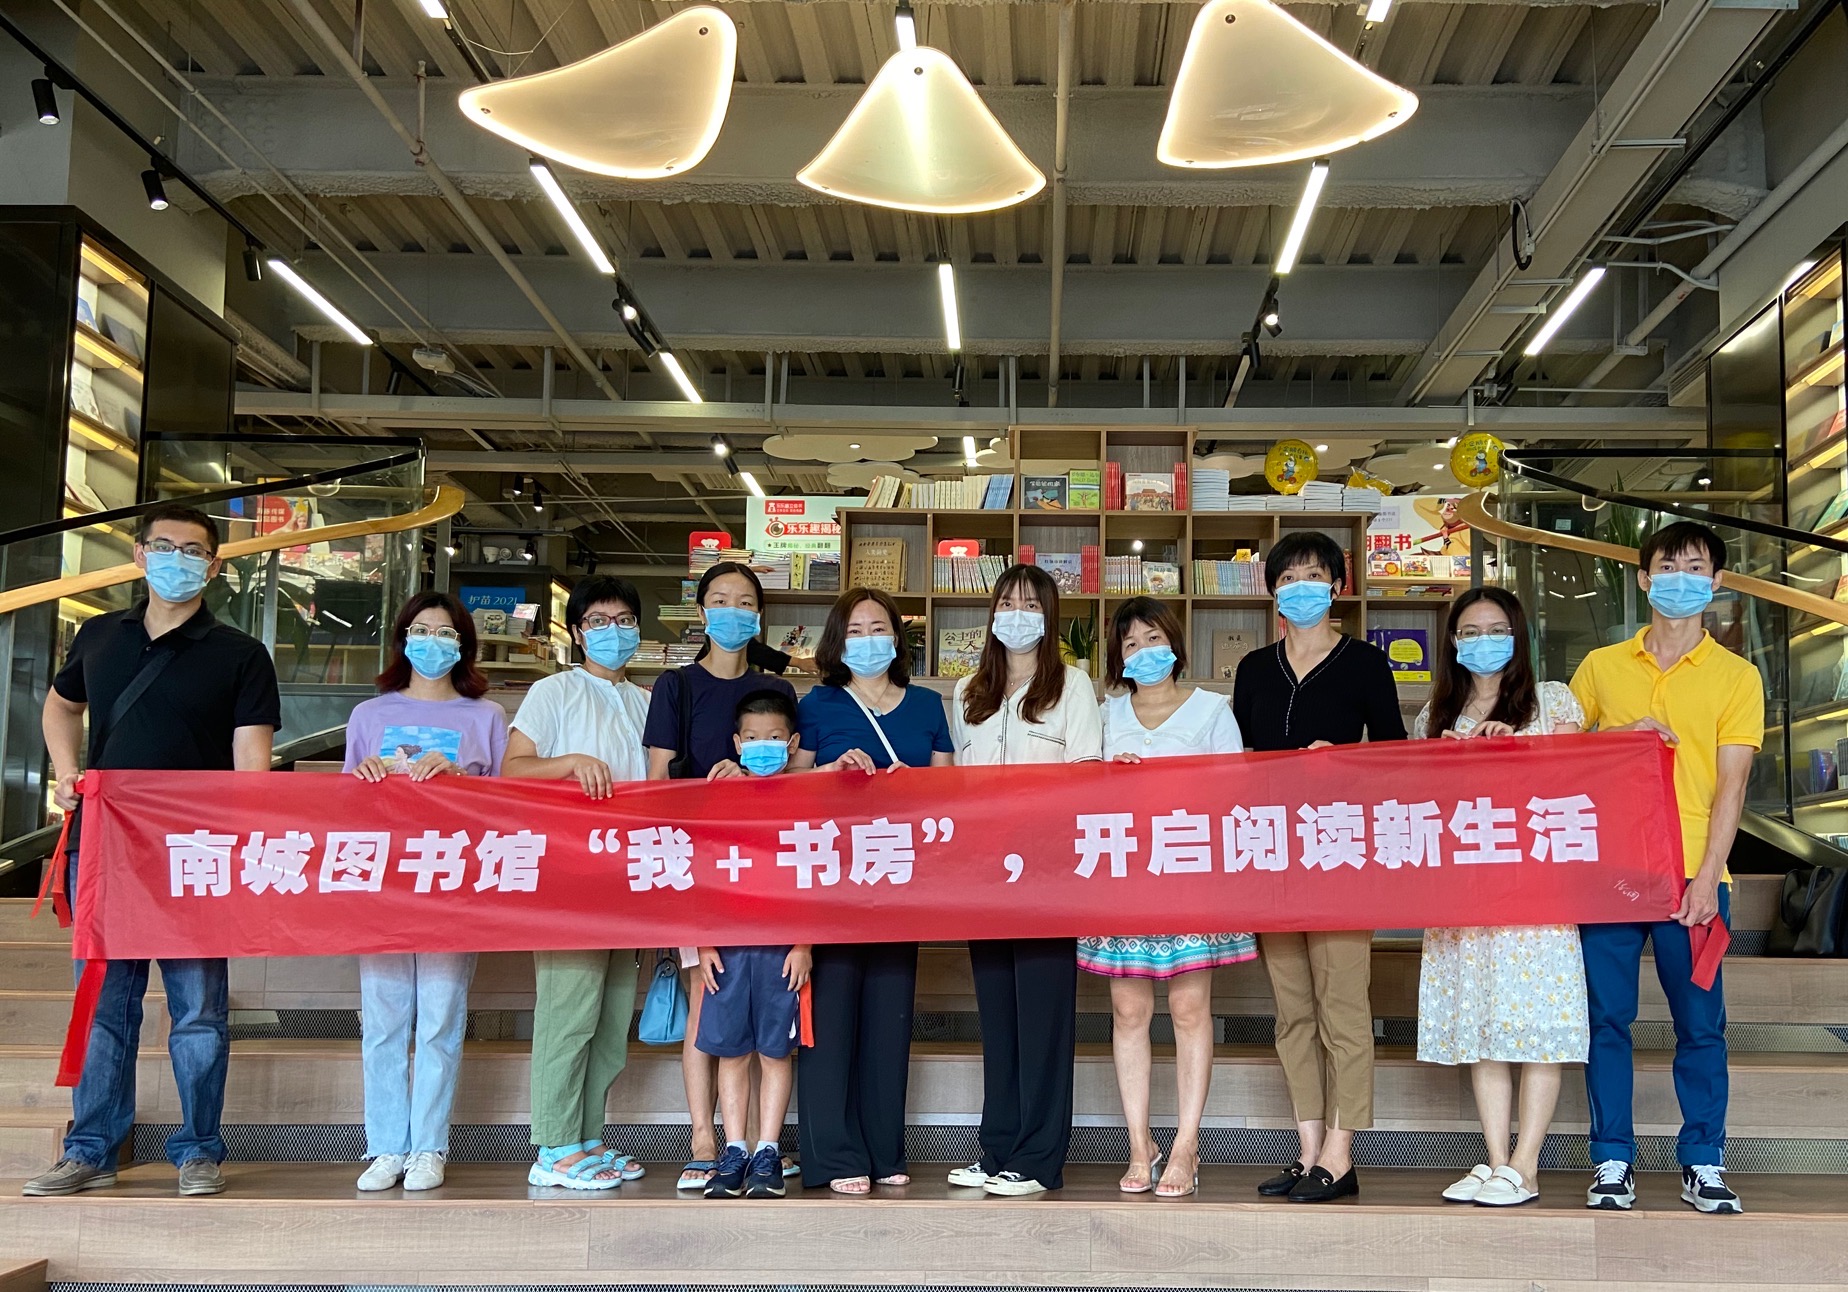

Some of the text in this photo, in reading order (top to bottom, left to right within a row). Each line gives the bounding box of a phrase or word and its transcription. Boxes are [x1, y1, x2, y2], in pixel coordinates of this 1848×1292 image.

[786, 523, 842, 534] 乐乐趣揭秘
[1366, 534, 1412, 551] 翻书
